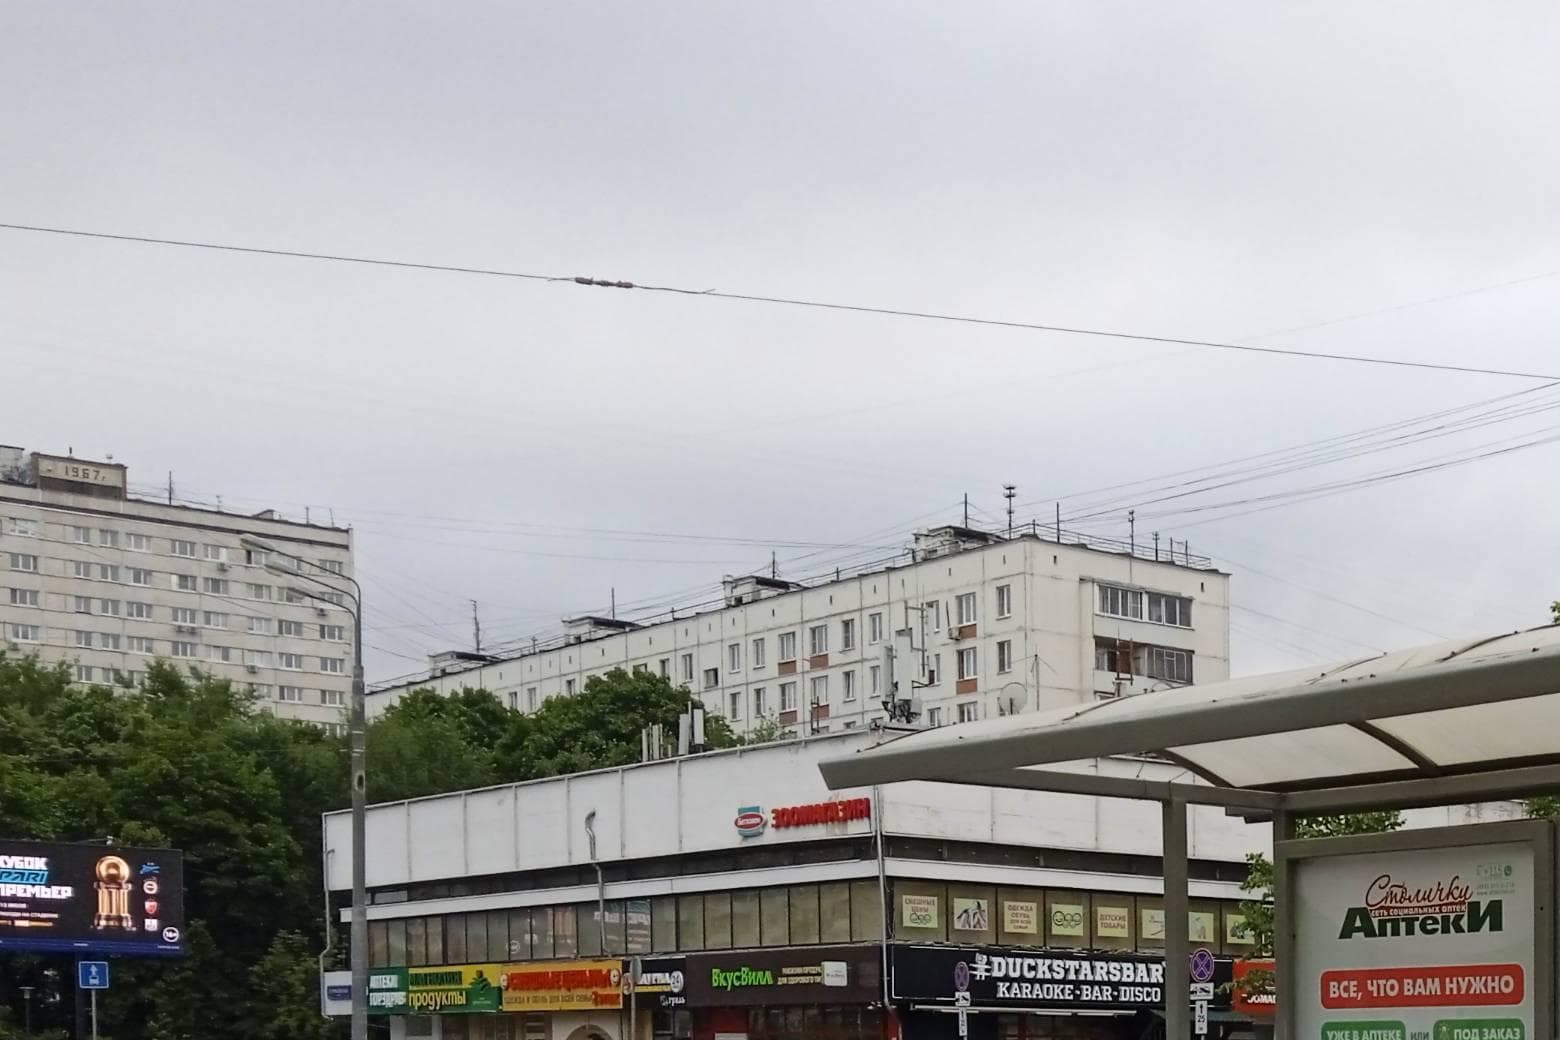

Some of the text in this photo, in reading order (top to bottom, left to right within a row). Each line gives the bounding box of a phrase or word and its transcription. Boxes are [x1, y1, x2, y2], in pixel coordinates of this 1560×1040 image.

[771, 798, 871, 829] ЗООМАГАЗИН
[1365, 874, 1474, 908] Столички
[1371, 904, 1467, 917] сеть социальных аптек
[711, 966, 773, 991] ВкусВилл
[1329, 974, 1515, 1000] ВСЕ, ЧТО ВАМ НУЖНО
[408, 990, 466, 1010] продукты
[1352, 1030, 1359, 1040] В
[1482, 1027, 1521, 1040] ЗАКАЗ
